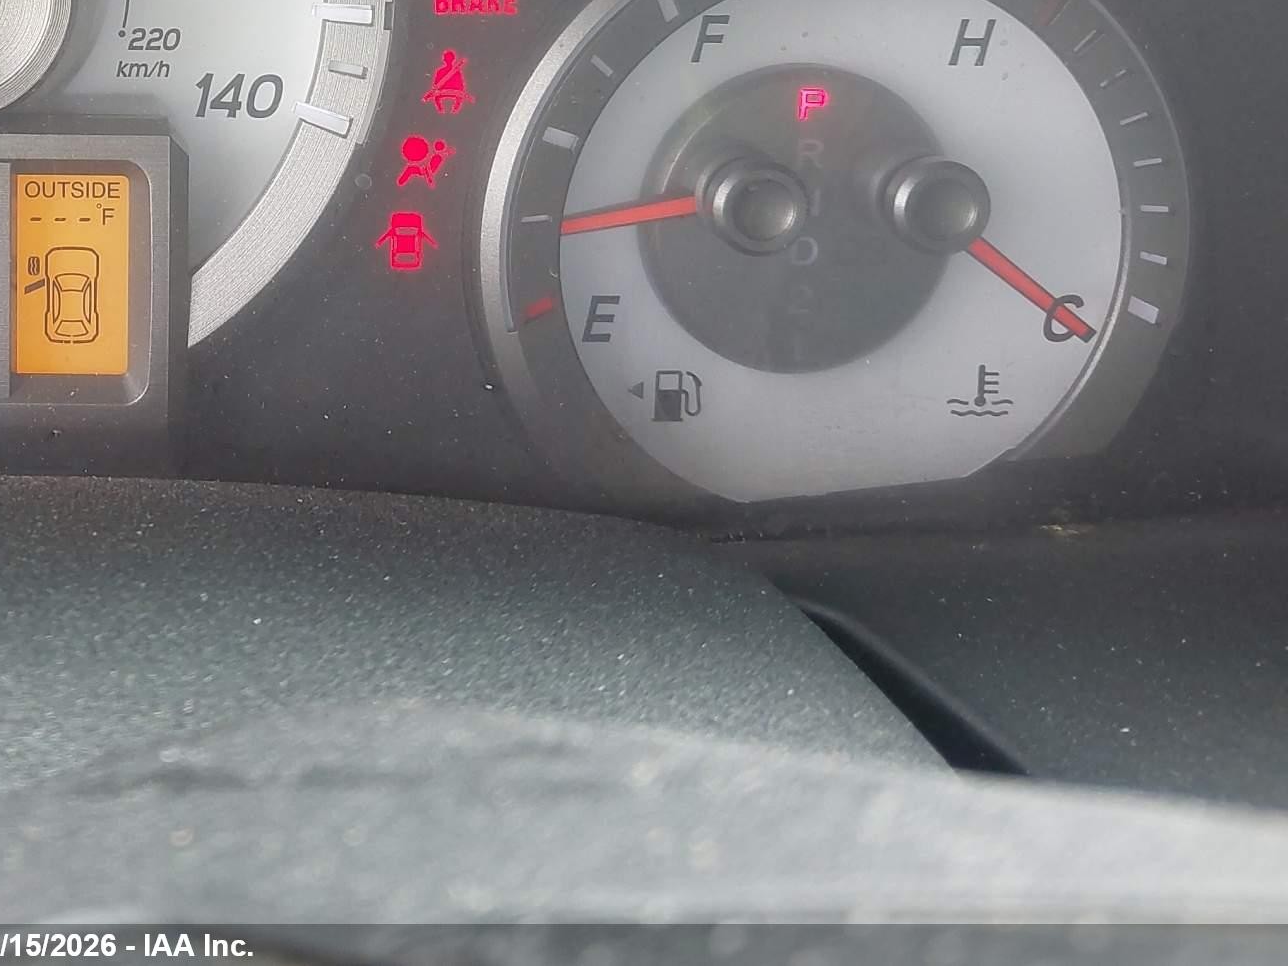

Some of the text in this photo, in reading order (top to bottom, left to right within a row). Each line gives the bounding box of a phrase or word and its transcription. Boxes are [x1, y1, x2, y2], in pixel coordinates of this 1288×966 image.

[127, 28, 181, 51] 220
[691, 15, 728, 62] F
[948, 19, 996, 66] H
[116, 60, 170, 78] km/h
[194, 73, 284, 118] 140
[798, 88, 829, 122] P
[796, 138, 824, 168] R
[24, 181, 121, 199] OUTSIDE
[789, 235, 819, 266] D
[582, 295, 620, 342] E
[1042, 295, 1084, 342] C
